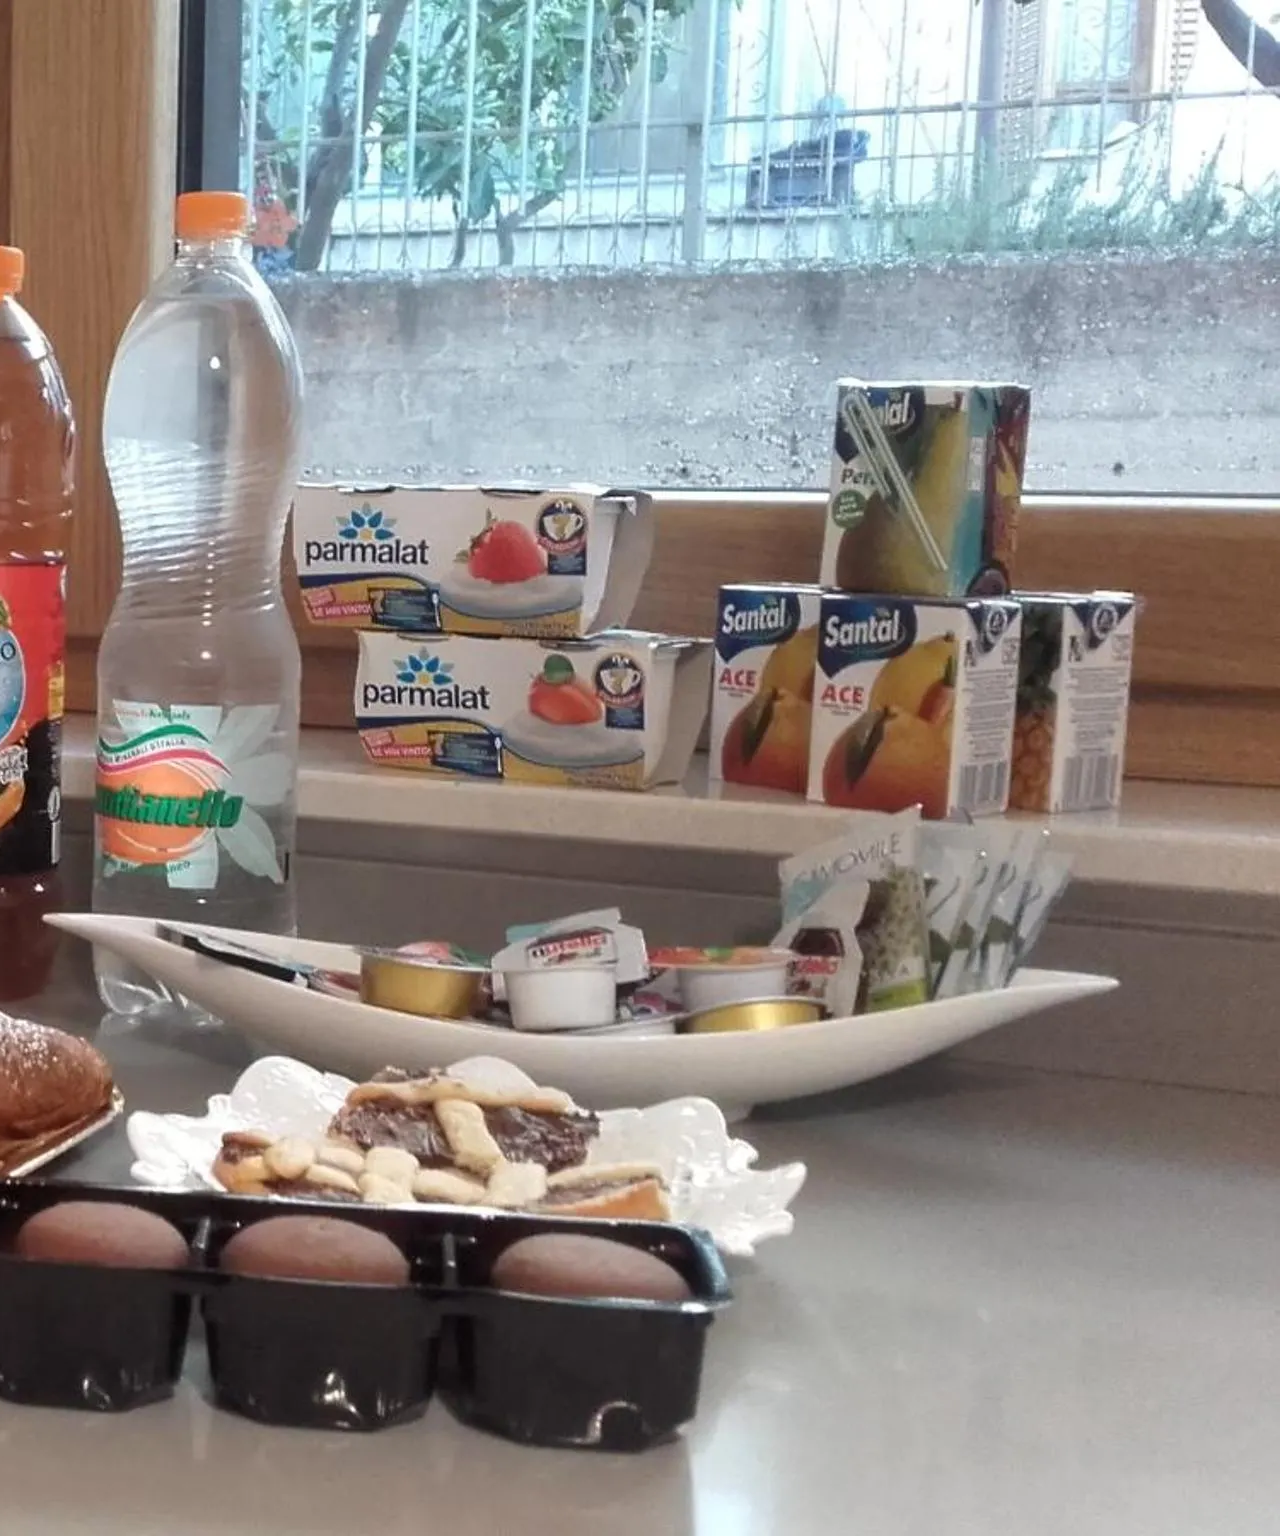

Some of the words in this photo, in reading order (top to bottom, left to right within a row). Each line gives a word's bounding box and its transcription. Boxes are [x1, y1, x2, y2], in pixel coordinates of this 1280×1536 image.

[305, 538, 429, 566] parmalat
[720, 668, 757, 687] ACE
[363, 682, 491, 710] parmalat
[821, 684, 865, 705] ACE
